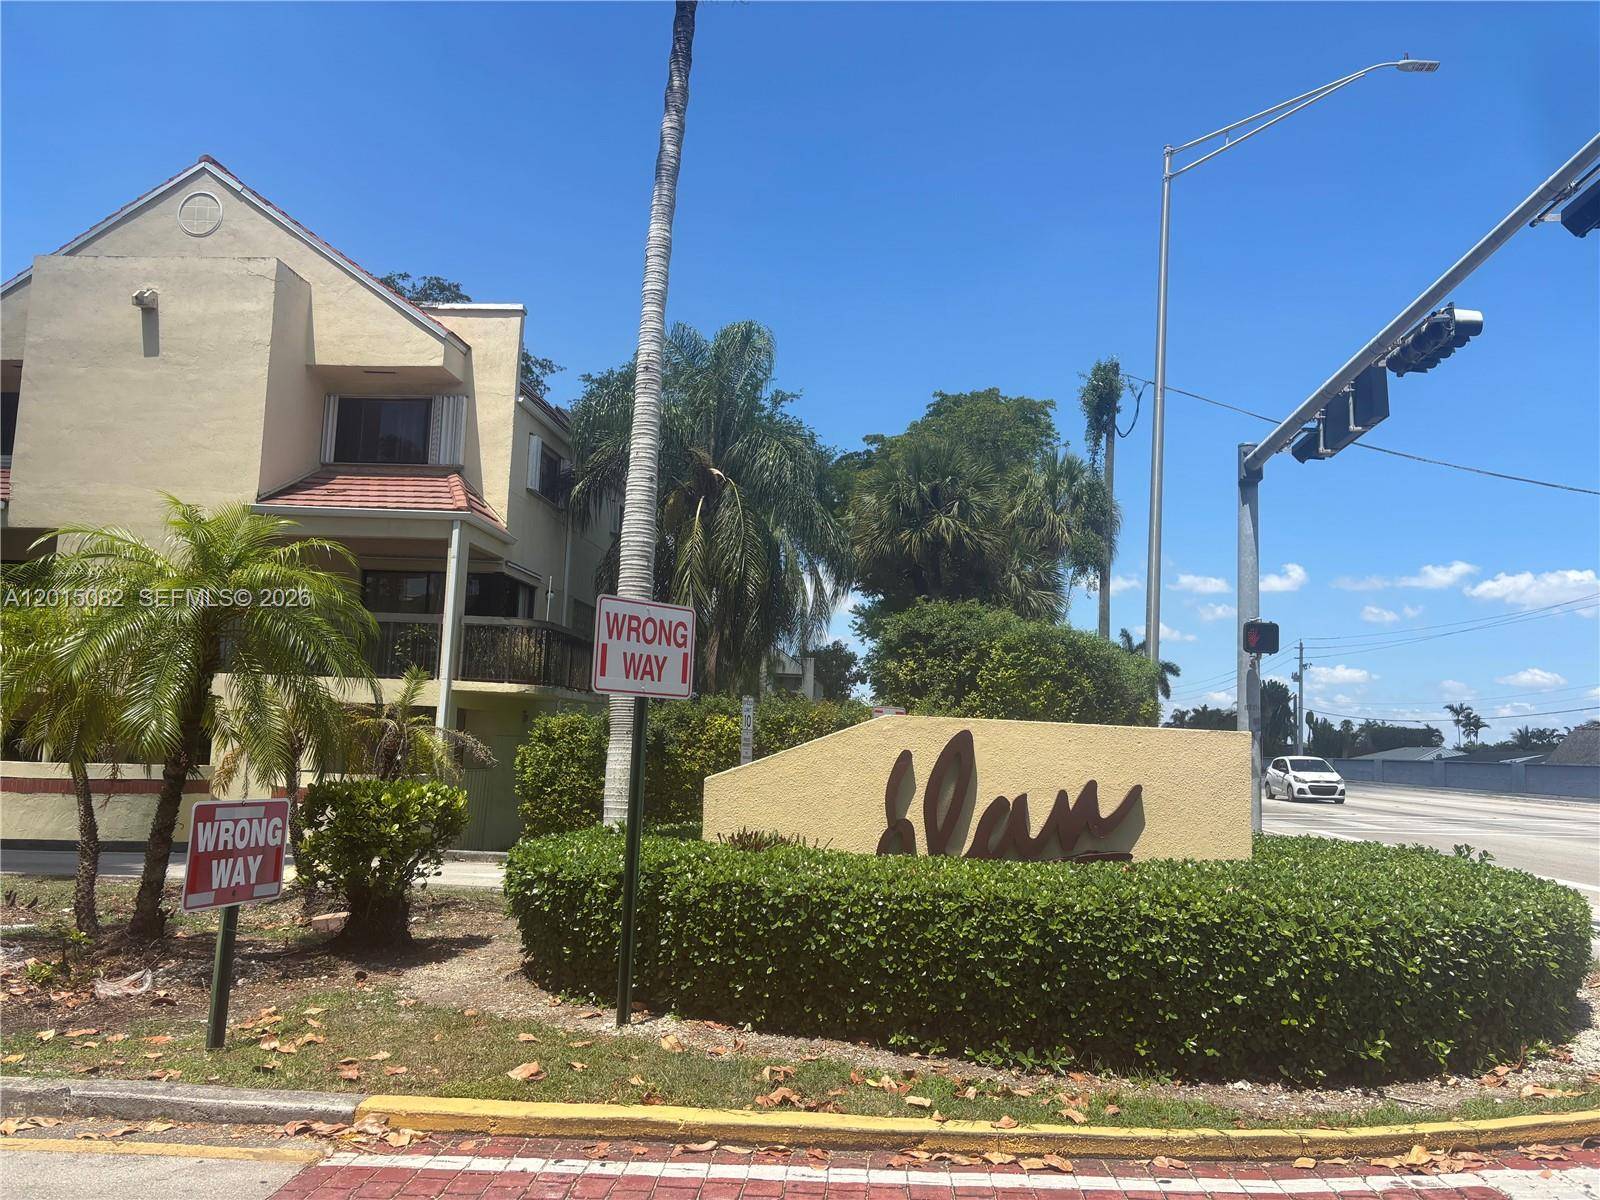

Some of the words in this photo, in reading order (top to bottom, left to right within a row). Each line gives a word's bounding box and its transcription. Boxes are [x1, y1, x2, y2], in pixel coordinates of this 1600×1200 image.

[605, 611, 688, 648] WRONG
[622, 651, 668, 682] WAY
[197, 816, 283, 853] WRONG
[211, 854, 263, 890] WAY
